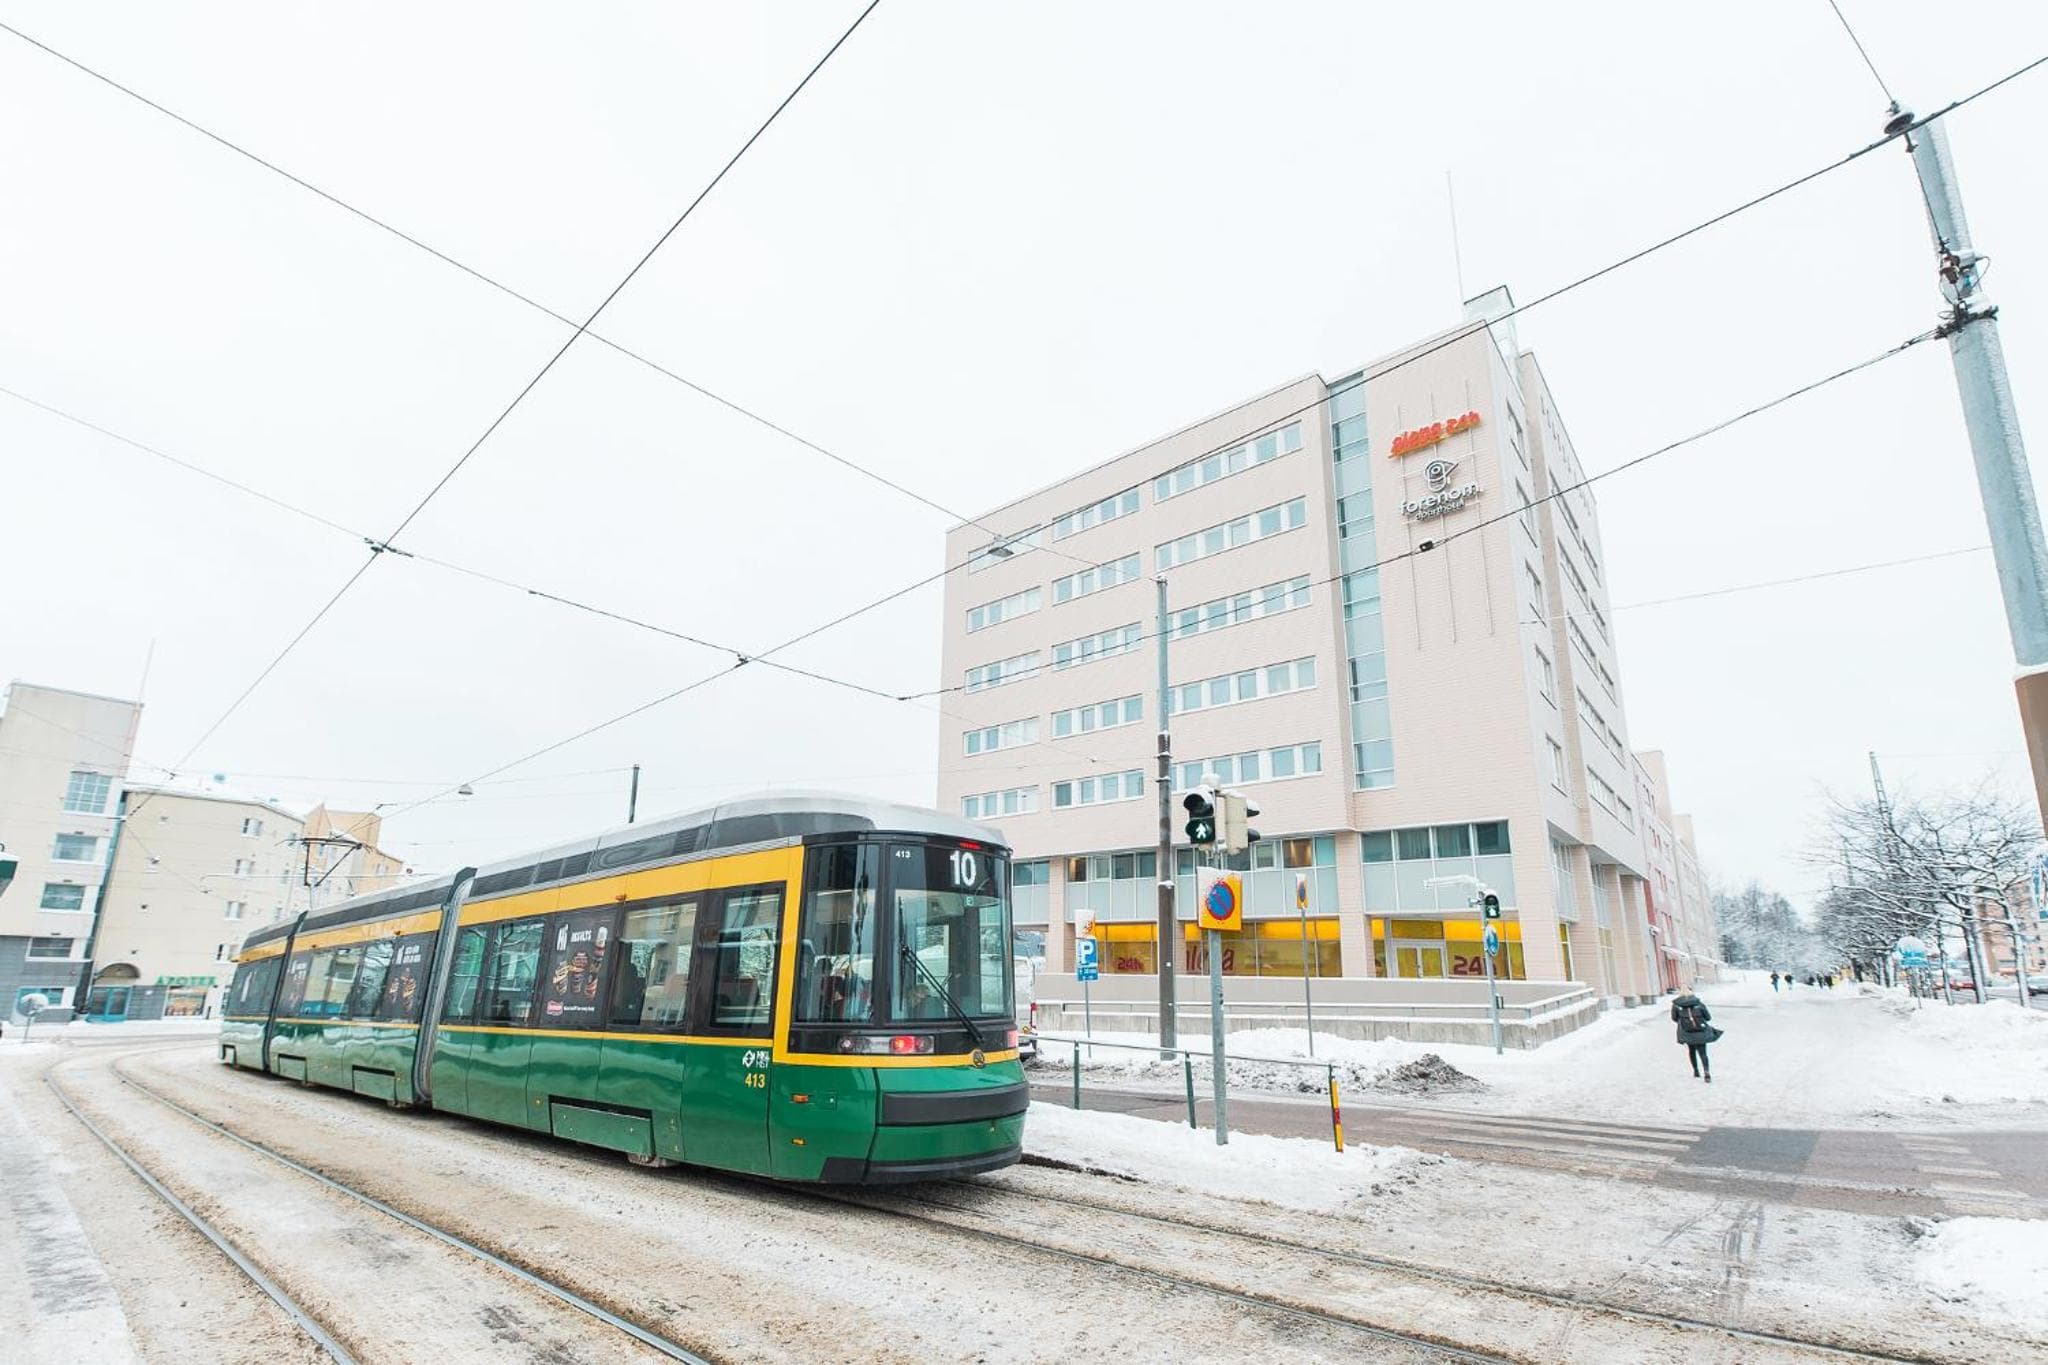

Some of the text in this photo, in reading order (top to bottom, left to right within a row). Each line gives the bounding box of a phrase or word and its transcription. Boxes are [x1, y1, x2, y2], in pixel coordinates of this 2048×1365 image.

[1401, 482, 1477, 516] forenom
[949, 850, 977, 887] 10
[1078, 940, 1095, 966] P
[745, 1072, 766, 1089] 413
